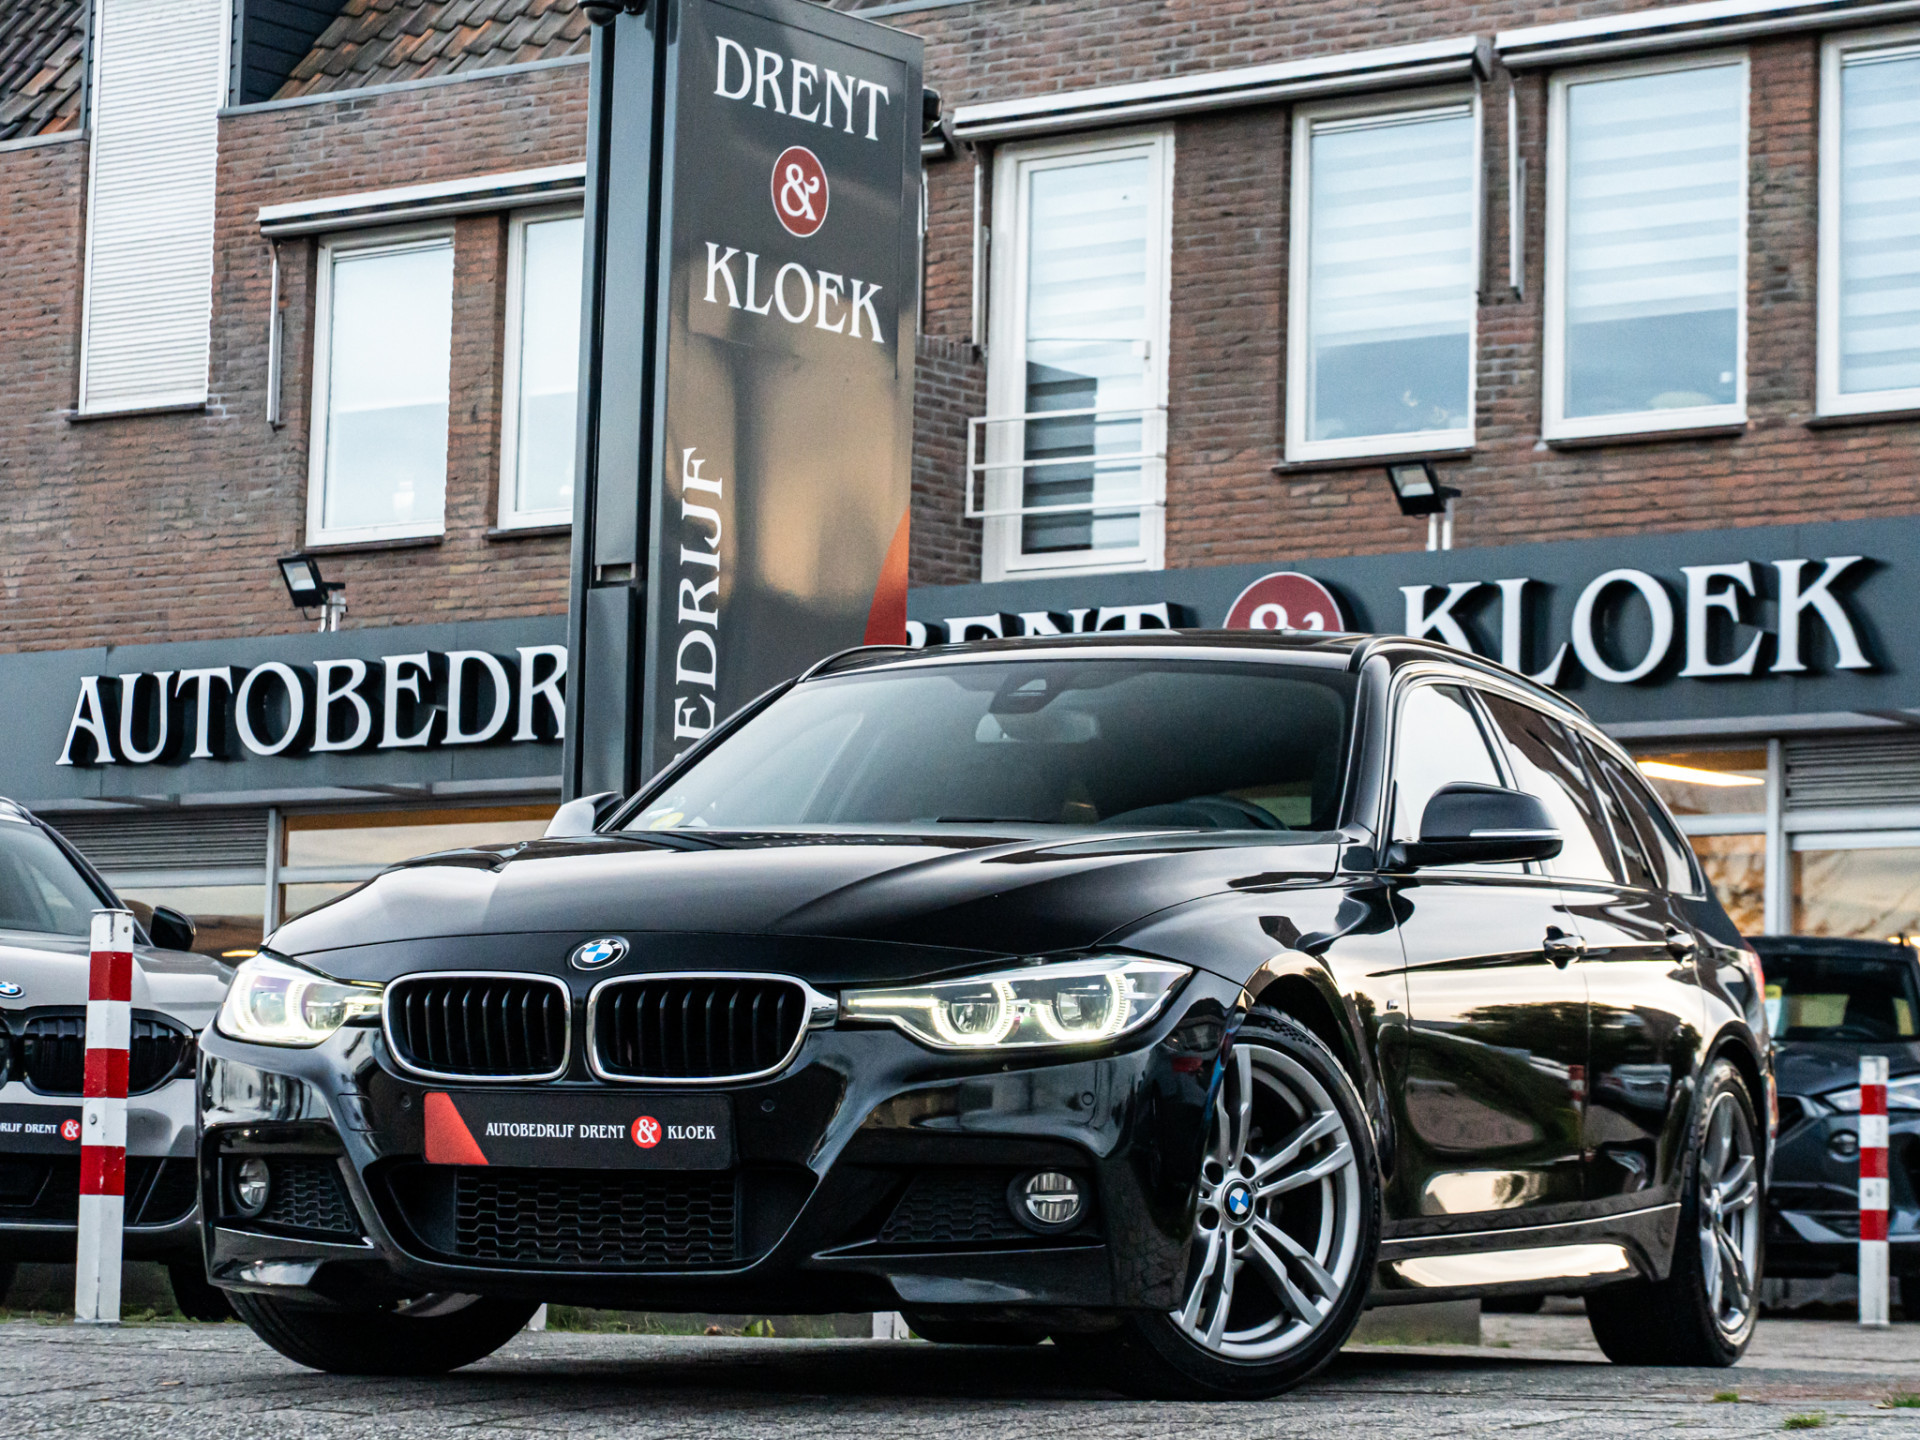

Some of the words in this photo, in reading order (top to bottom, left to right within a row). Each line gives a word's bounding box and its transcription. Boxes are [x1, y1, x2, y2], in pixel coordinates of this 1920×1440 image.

[713, 35, 890, 142] DRENT
[780, 163, 820, 222] &
[702, 241, 885, 344] KLOEK
[672, 446, 723, 759] EDRIJF
[1398, 555, 1874, 686] KLOEK
[0, 1122, 23, 1133] RIJF
[24, 1123, 58, 1134] DRENT
[64, 1121, 79, 1138] &
[485, 1122, 575, 1138] AUTOBEDRIJF
[579, 1124, 626, 1139] DRENT
[636, 1118, 658, 1144] &
[667, 1125, 716, 1140] KLOEK
